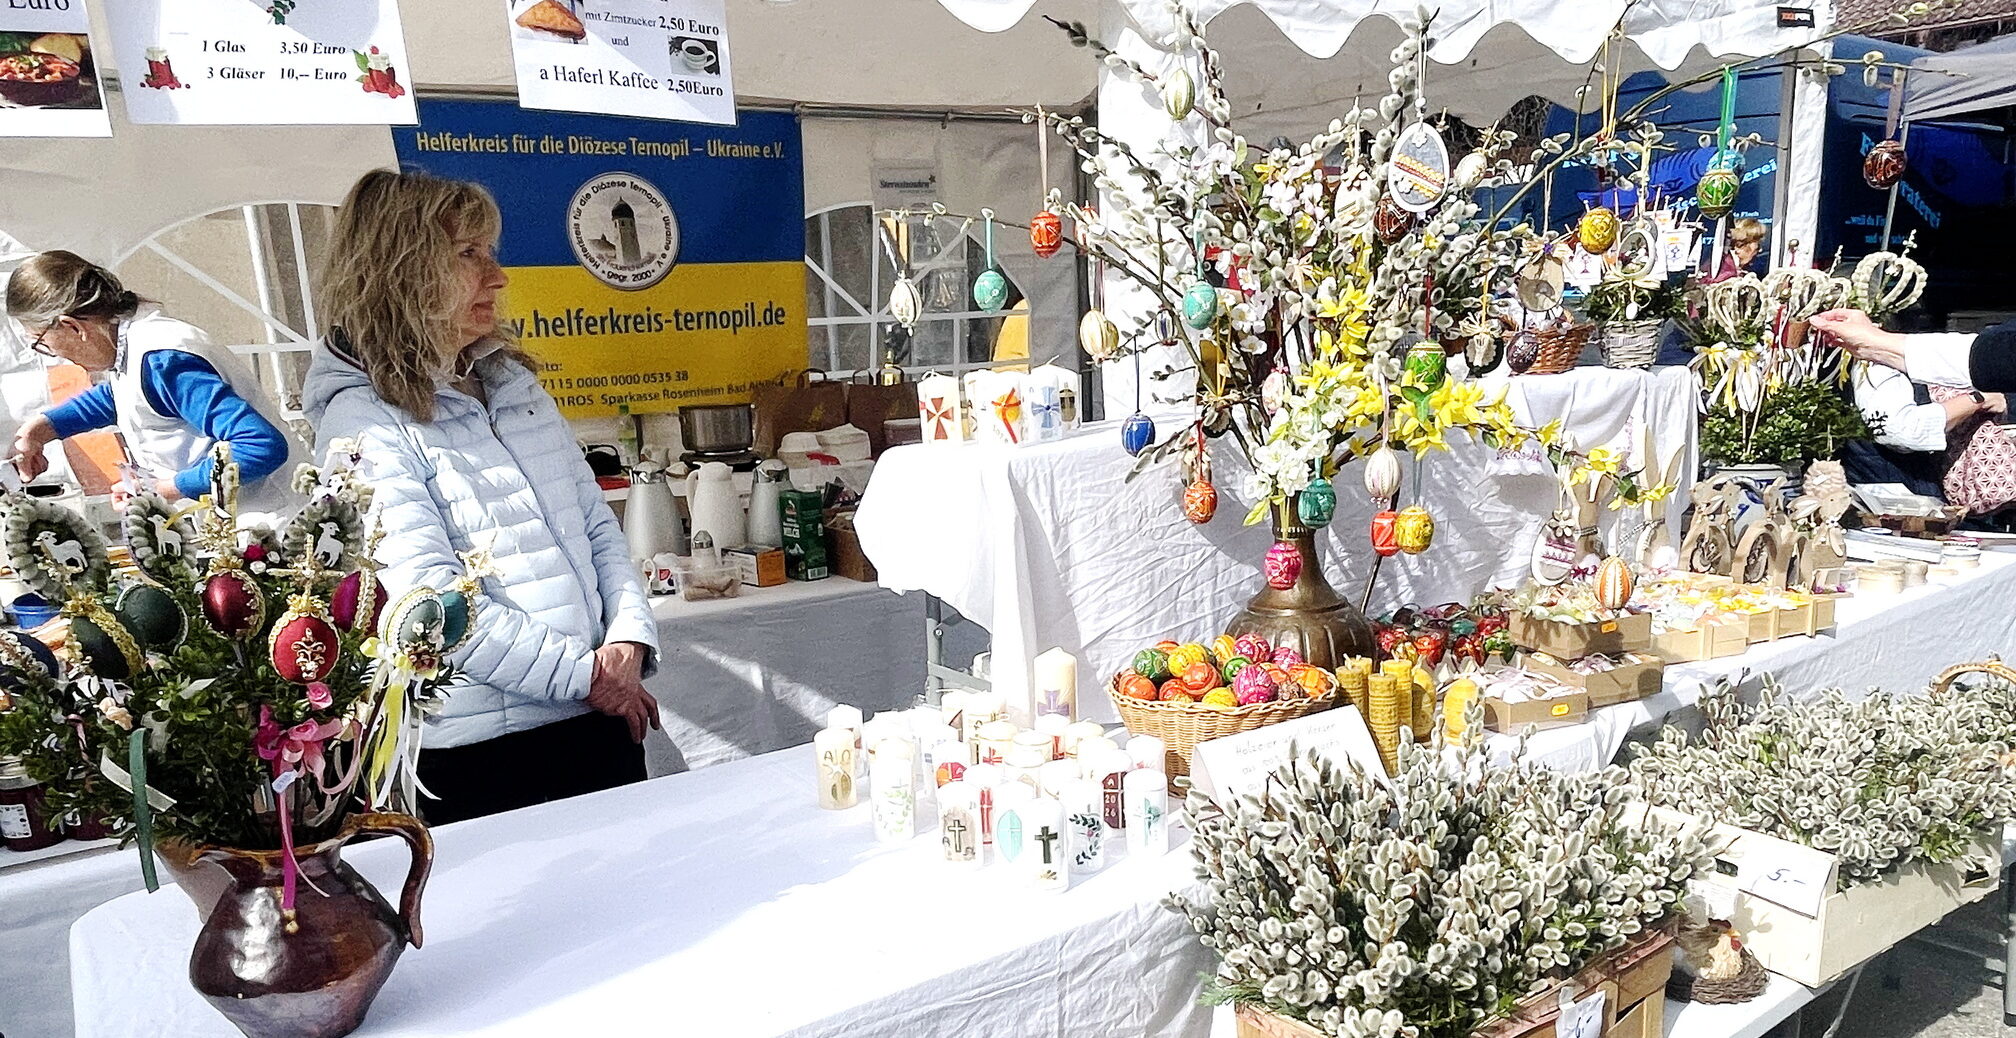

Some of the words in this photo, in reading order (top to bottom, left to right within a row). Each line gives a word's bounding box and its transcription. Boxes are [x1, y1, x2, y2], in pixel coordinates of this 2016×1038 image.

[585, 11, 602, 21] mit
[604, 11, 657, 28] Zimtzucker
[658, 16, 685, 31] 2,50
[689, 19, 720, 36] Euro
[202, 40, 208, 52] 1
[214, 40, 246, 53] Glas
[280, 41, 308, 55] 3,50
[313, 42, 346, 55] Euro
[611, 36, 629, 46] und
[207, 67, 213, 79] 3
[219, 66, 265, 80] Gläser
[314, 68, 347, 80] Euro
[540, 68, 549, 80] a
[553, 65, 604, 85] Haferl
[609, 70, 659, 90] Kaffee
[416, 132, 508, 154] Helferkreis
[513, 134, 535, 154] für
[539, 135, 564, 155] die
[568, 136, 626, 156] Diözese
[629, 137, 690, 160] Ternopil
[707, 138, 761, 158] Ukraine
[763, 142, 785, 159] e.V.
[632, 270, 652, 282] 2000
[577, 376, 608, 388] 0000
[610, 373, 639, 386] 0000
[643, 370, 672, 383] 0535
[674, 370, 689, 382] 38
[601, 391, 660, 406] Sparkasse
[663, 386, 725, 399] Rosenheim
[727, 382, 748, 395] Bad
[1104, 793, 1117, 804] 20
[1104, 807, 1117, 817] 26
